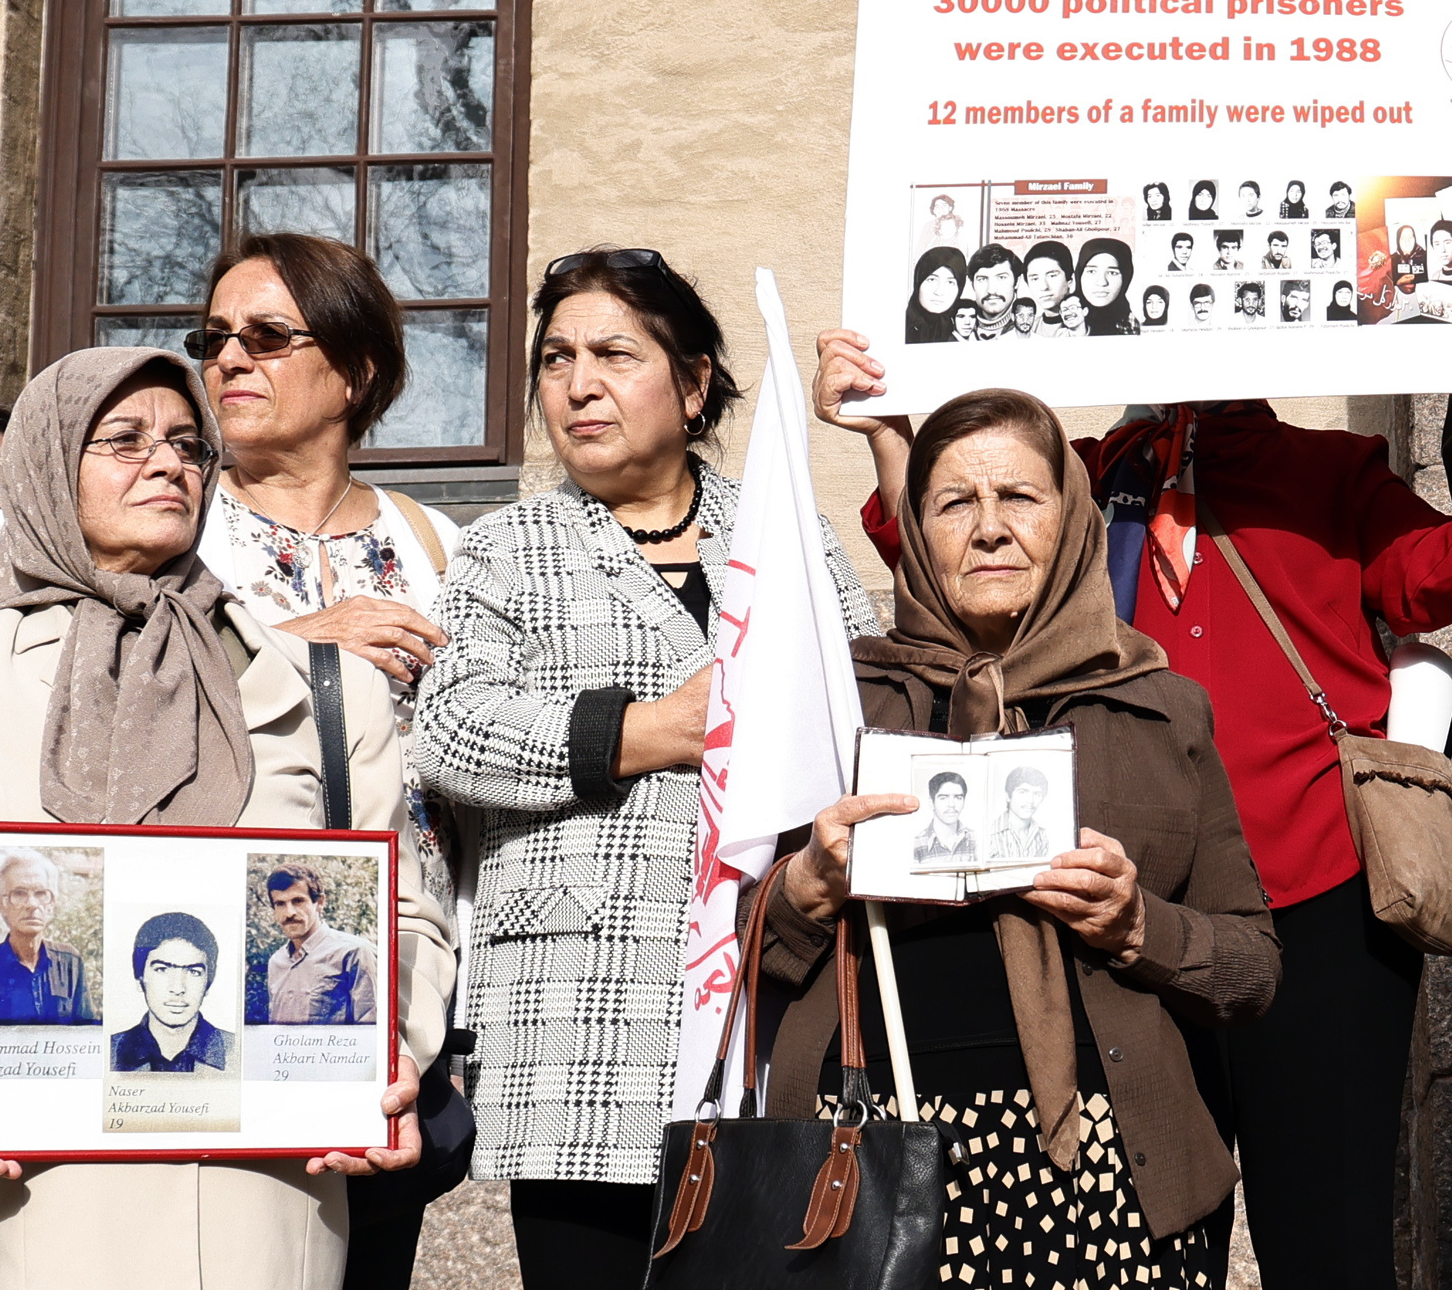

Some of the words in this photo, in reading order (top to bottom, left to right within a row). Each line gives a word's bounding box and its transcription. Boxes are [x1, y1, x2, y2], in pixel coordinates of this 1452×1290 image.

[953, 40, 1044, 61] were
[1055, 35, 1229, 61] executed
[1243, 35, 1276, 61] in
[1289, 36, 1382, 63] 1988
[927, 100, 957, 125] 12
[964, 99, 1079, 125] members
[1087, 97, 1113, 124] of
[1119, 103, 1134, 124] a
[1141, 96, 1219, 129] family
[1225, 103, 1286, 124] were
[1292, 99, 1366, 129] wiped
[1372, 100, 1414, 125] out
[1028, 182, 1061, 191] Mirzaei
[1064, 181, 1094, 192] Family
[43, 1040, 102, 1055] Hossein
[273, 1034, 323, 1047] Gholam
[327, 1034, 357, 1048] Reza
[272, 1052, 315, 1064] Akbari
[319, 1052, 370, 1064] Namdar
[26, 1061, 77, 1080] Yousefi
[273, 1069, 289, 1081] 29
[108, 1085, 145, 1097] Naser
[107, 1102, 166, 1114] Akbarzad
[168, 1102, 210, 1117] Yousefi
[109, 1118, 124, 1129] 19
